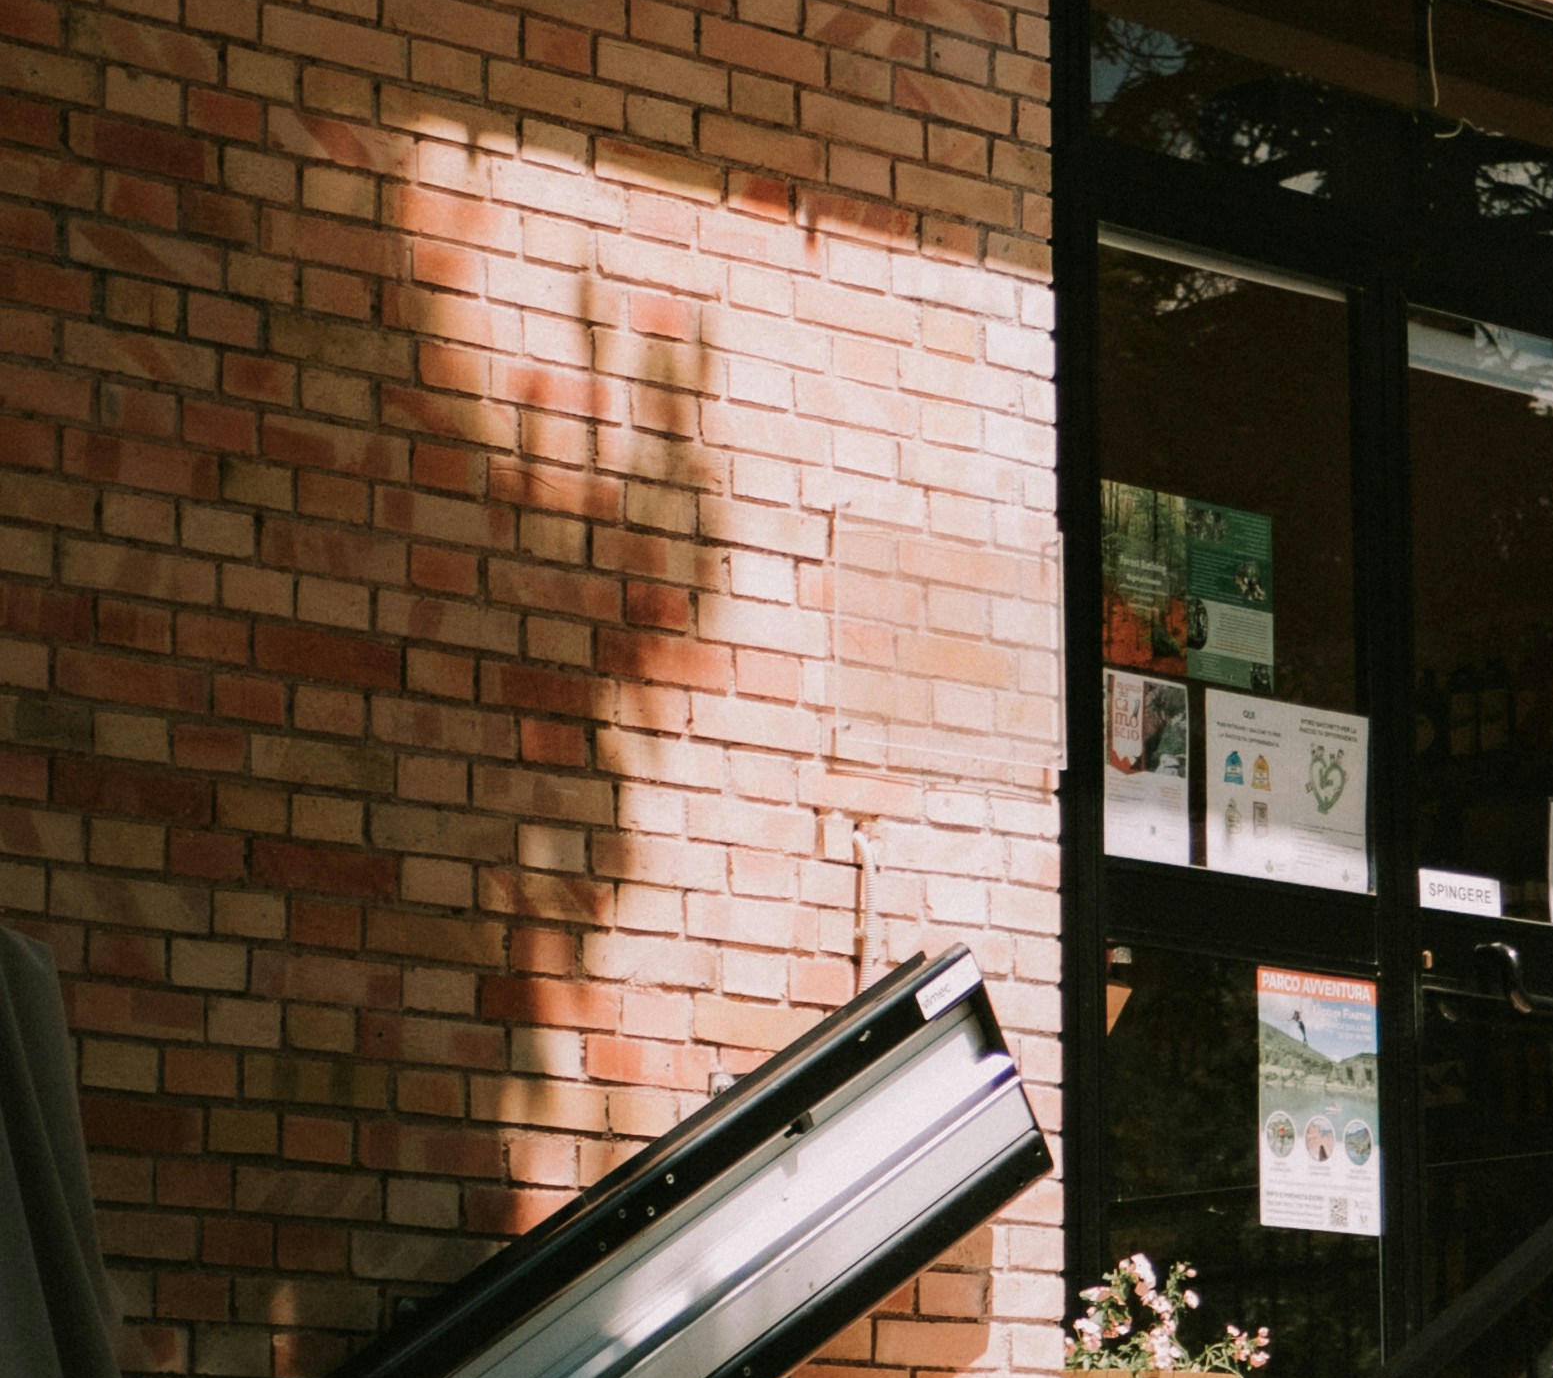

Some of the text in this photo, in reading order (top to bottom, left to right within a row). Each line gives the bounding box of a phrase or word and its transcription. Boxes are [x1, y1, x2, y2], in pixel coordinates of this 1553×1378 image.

[1429, 882, 1492, 904] SPINGERE
[1261, 972, 1371, 1001] PARCO AVVENTURA
